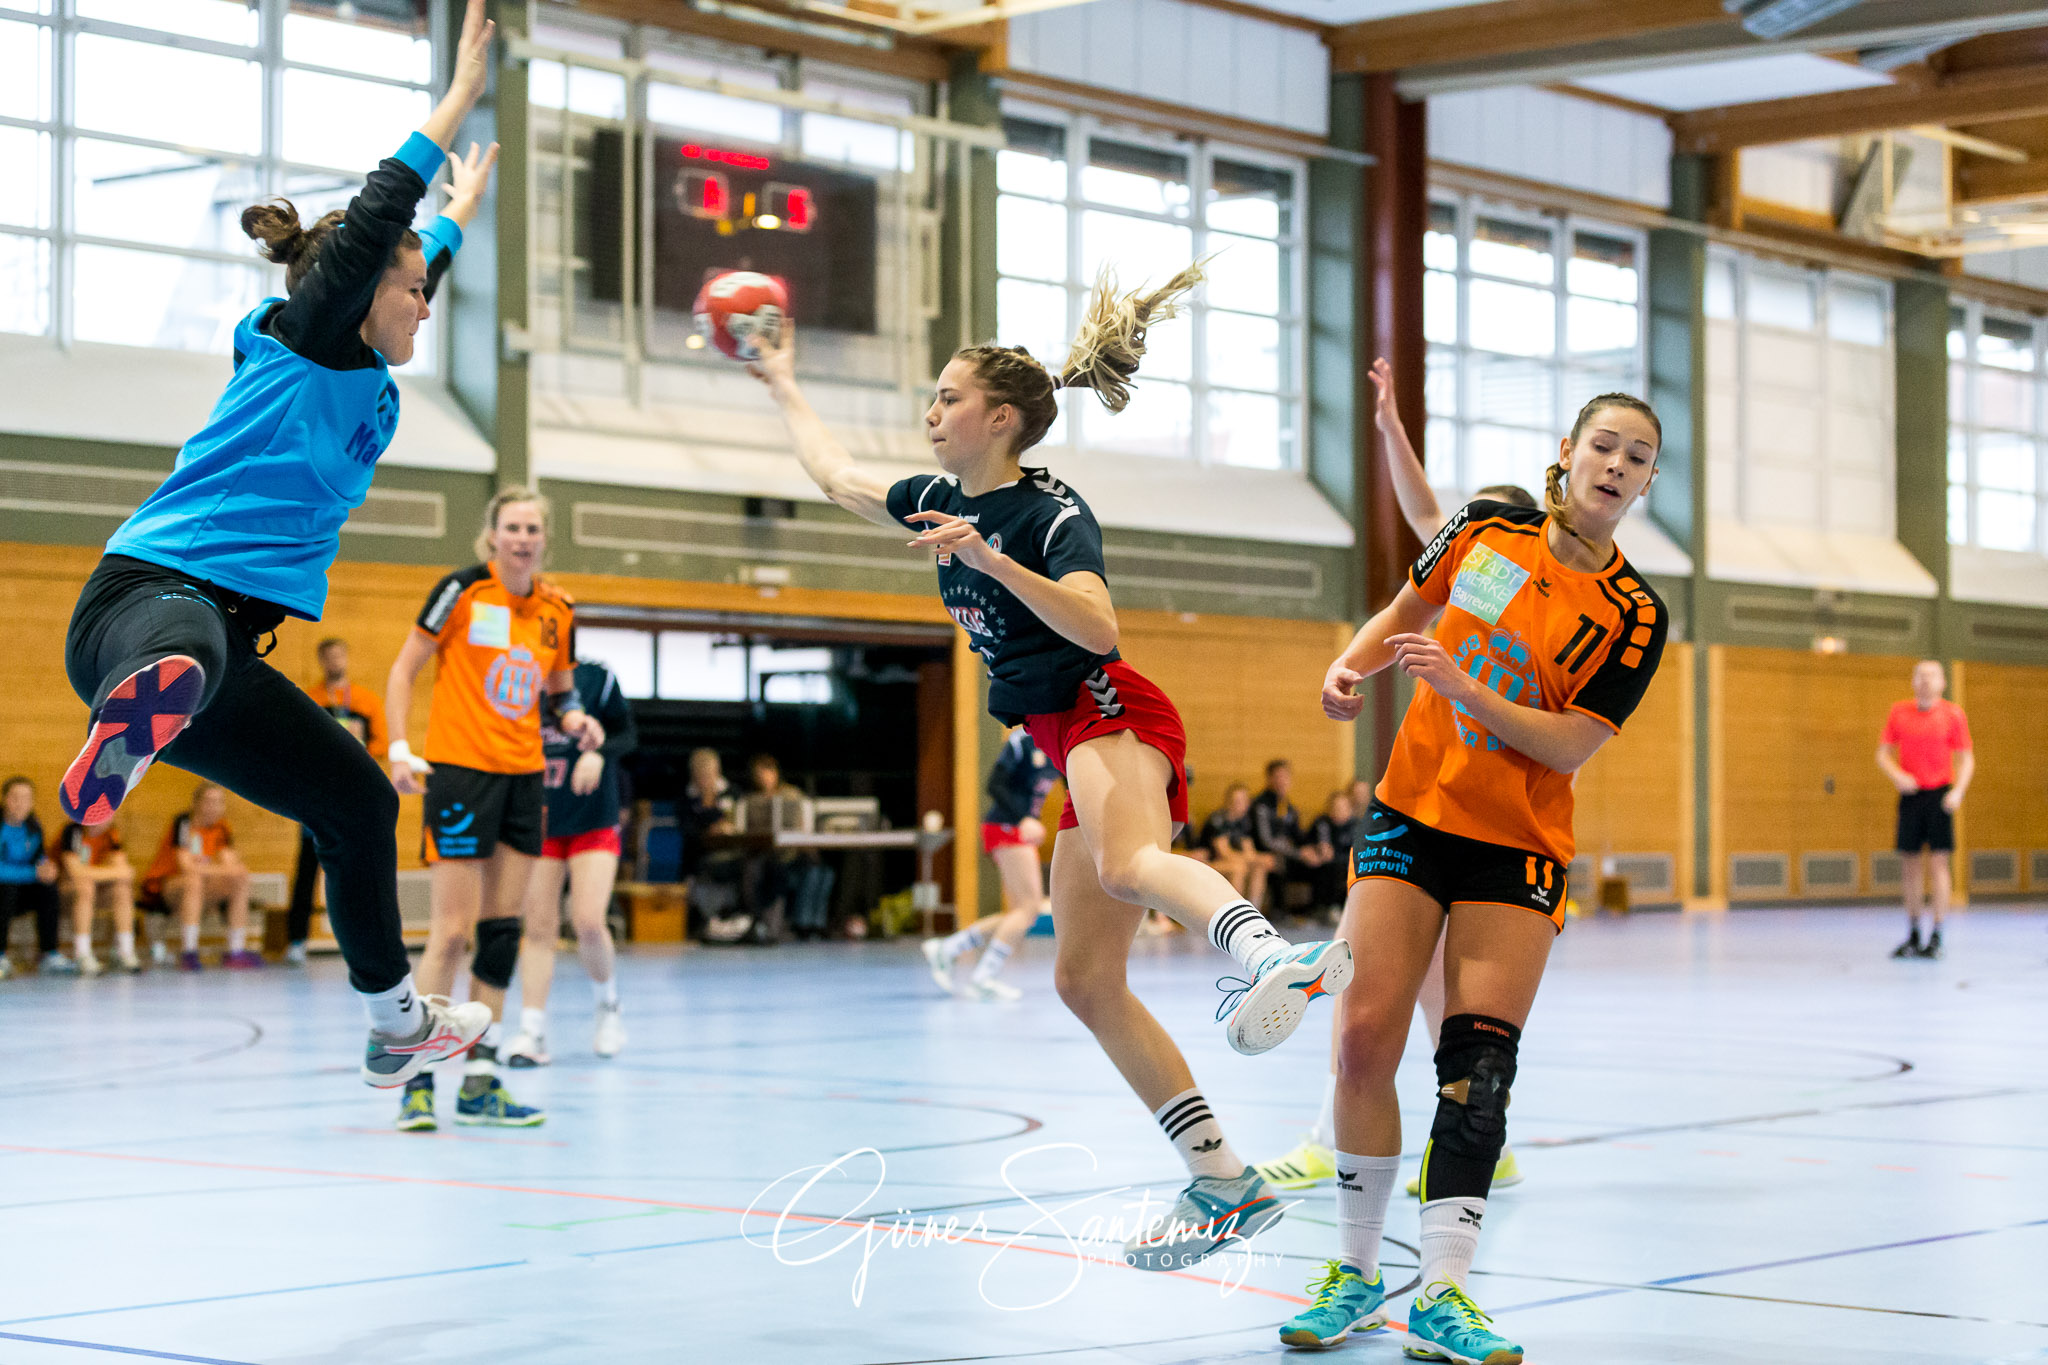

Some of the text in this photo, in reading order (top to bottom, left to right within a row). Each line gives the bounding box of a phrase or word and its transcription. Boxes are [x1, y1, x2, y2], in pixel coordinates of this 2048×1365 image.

[1417, 506, 1469, 571] MEDICLIN
[1468, 550, 1522, 586] STADT
[1460, 566, 1511, 602] WERKE
[1453, 586, 1498, 616] Bayreuth
[1554, 613, 1609, 675] 11
[1357, 860, 1408, 875] Bayreuth
[1381, 846, 1414, 864] team
[1525, 856, 1554, 889] 11
[1530, 893, 1550, 907] erima
[1473, 1021, 1510, 1038] Kempa
